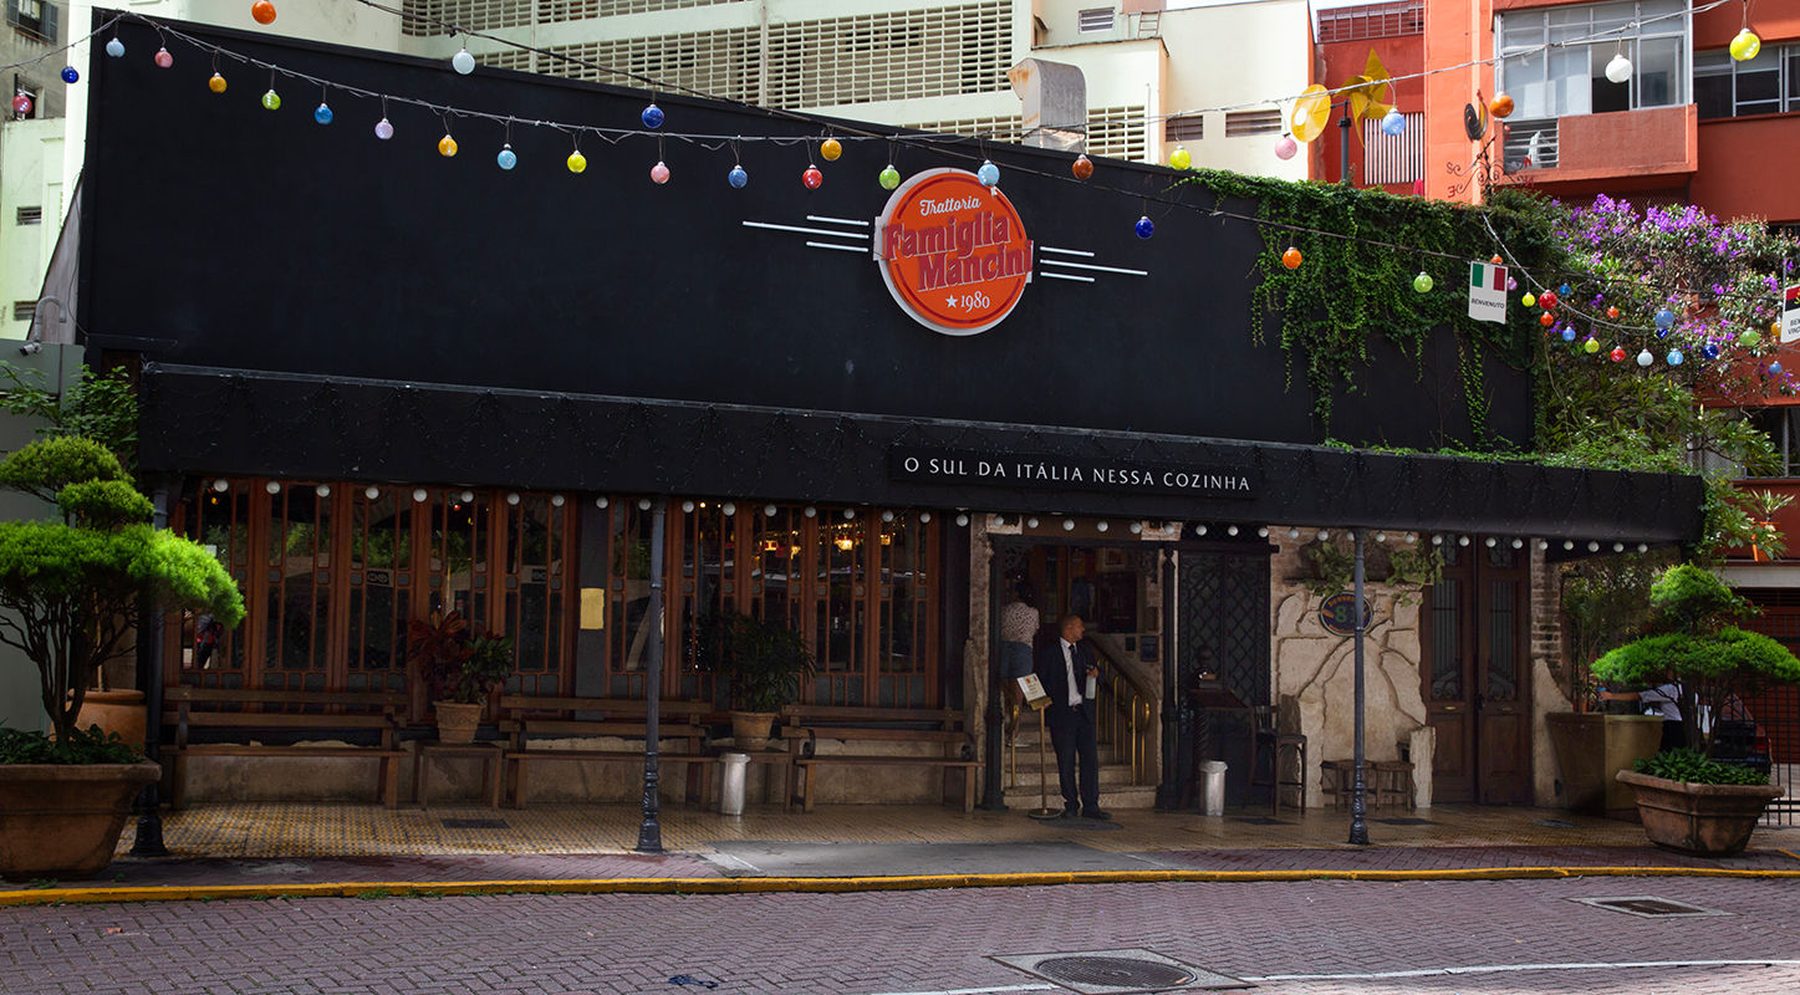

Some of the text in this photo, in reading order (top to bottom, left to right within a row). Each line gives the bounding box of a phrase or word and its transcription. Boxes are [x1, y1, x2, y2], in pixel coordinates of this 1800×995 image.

[919, 195, 982, 217] Trattoria
[882, 211, 1012, 261] Famiglia
[917, 240, 1034, 293] Mancini
[960, 290, 991, 313] 1980
[1471, 298, 1505, 309] BENVENUTO
[904, 457, 1250, 491] O SUL DA ITÁLIA NESSA COZINHA
